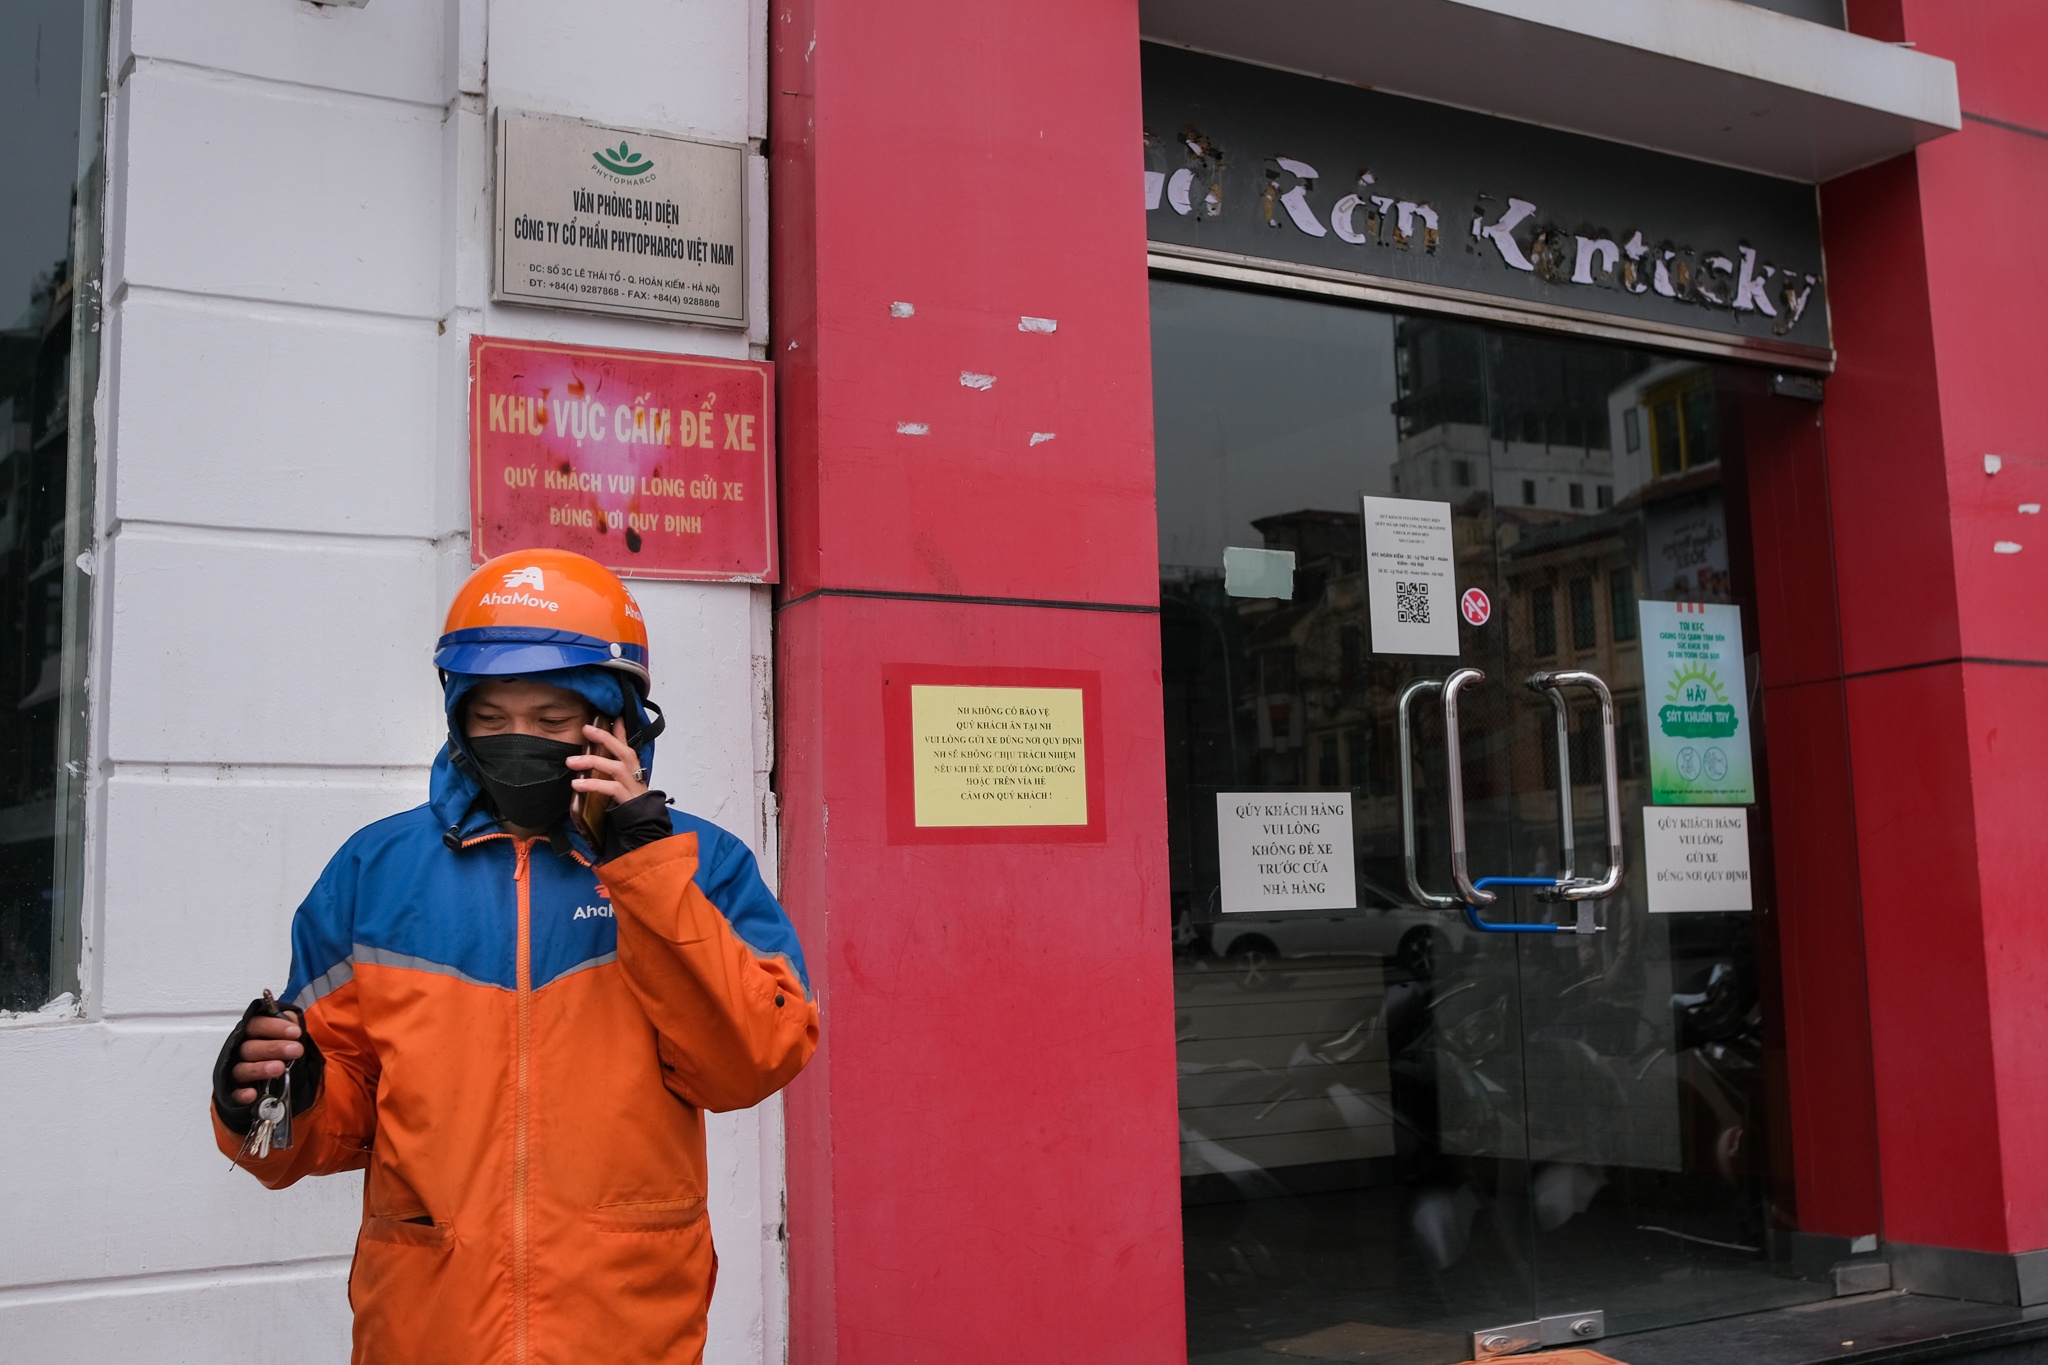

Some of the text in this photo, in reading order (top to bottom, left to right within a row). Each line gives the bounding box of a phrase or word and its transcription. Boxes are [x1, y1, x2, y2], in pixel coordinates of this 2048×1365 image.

[591, 164, 657, 186] PHYTOPHARCO
[573, 187, 679, 228] VĂN PHÒNG ĐẠI DIỆN
[514, 214, 734, 266] CÔNG TY CỔ PHẦN PHYTOPHARCO VIỆT NAM
[529, 264, 545, 273] ĐC:
[547, 263, 559, 274] SỐ
[562, 268, 572, 276] 3C
[575, 267, 585, 278] LÊ
[588, 269, 607, 280] THÁI
[609, 270, 620, 281] TỔ
[628, 276, 636, 285] Q.
[639, 276, 662, 287] HOÀN
[665, 278, 685, 289] KIẾM
[692, 281, 703, 292] HÀ
[706, 283, 720, 295] NỘI
[529, 279, 545, 288] ĐT:
[549, 281, 578, 293] +84(4)
[581, 285, 619, 296] 9287868
[628, 290, 650, 300] FAX:
[653, 293, 681, 305] +84(4)
[683, 296, 720, 308] 9288808
[489, 392, 756, 451] KHU VỰC CẤM ĐỂ XE
[504, 464, 537, 488] QUÝ
[545, 466, 601, 492] KHÁCH
[608, 474, 635, 494] VUI
[690, 474, 717, 500] GỬI
[723, 481, 744, 501] XE
[550, 504, 593, 528] ĐÚNG
[628, 513, 659, 533] QUY
[664, 515, 701, 537] ĐỊNH
[479, 592, 559, 612] AhaMove
[1692, 622, 1704, 631] KFC
[972, 706, 1003, 715] KHÔNG
[1005, 706, 1017, 715] CÓ
[1039, 707, 1050, 717] VỆ
[977, 720, 1008, 729] KHÁCH
[1023, 723, 1037, 731] TẠI
[982, 792, 994, 800] ƠN
[1017, 790, 1047, 800] KHÁCH
[1265, 802, 1307, 816] KHÁCH
[1311, 802, 1344, 816] HÀNG
[1263, 821, 1320, 835] VUI LÒNG
[1680, 816, 1713, 829] KHÁCH
[1715, 816, 1741, 829] HÀNG
[1679, 832, 1723, 845] VUI LÒNG
[1252, 842, 1296, 856] KHÔNG
[1317, 844, 1333, 854] XE
[1706, 853, 1719, 863] XE
[1258, 860, 1300, 875] TRƯỚC
[1263, 880, 1325, 895] NHÀ HÀNG
